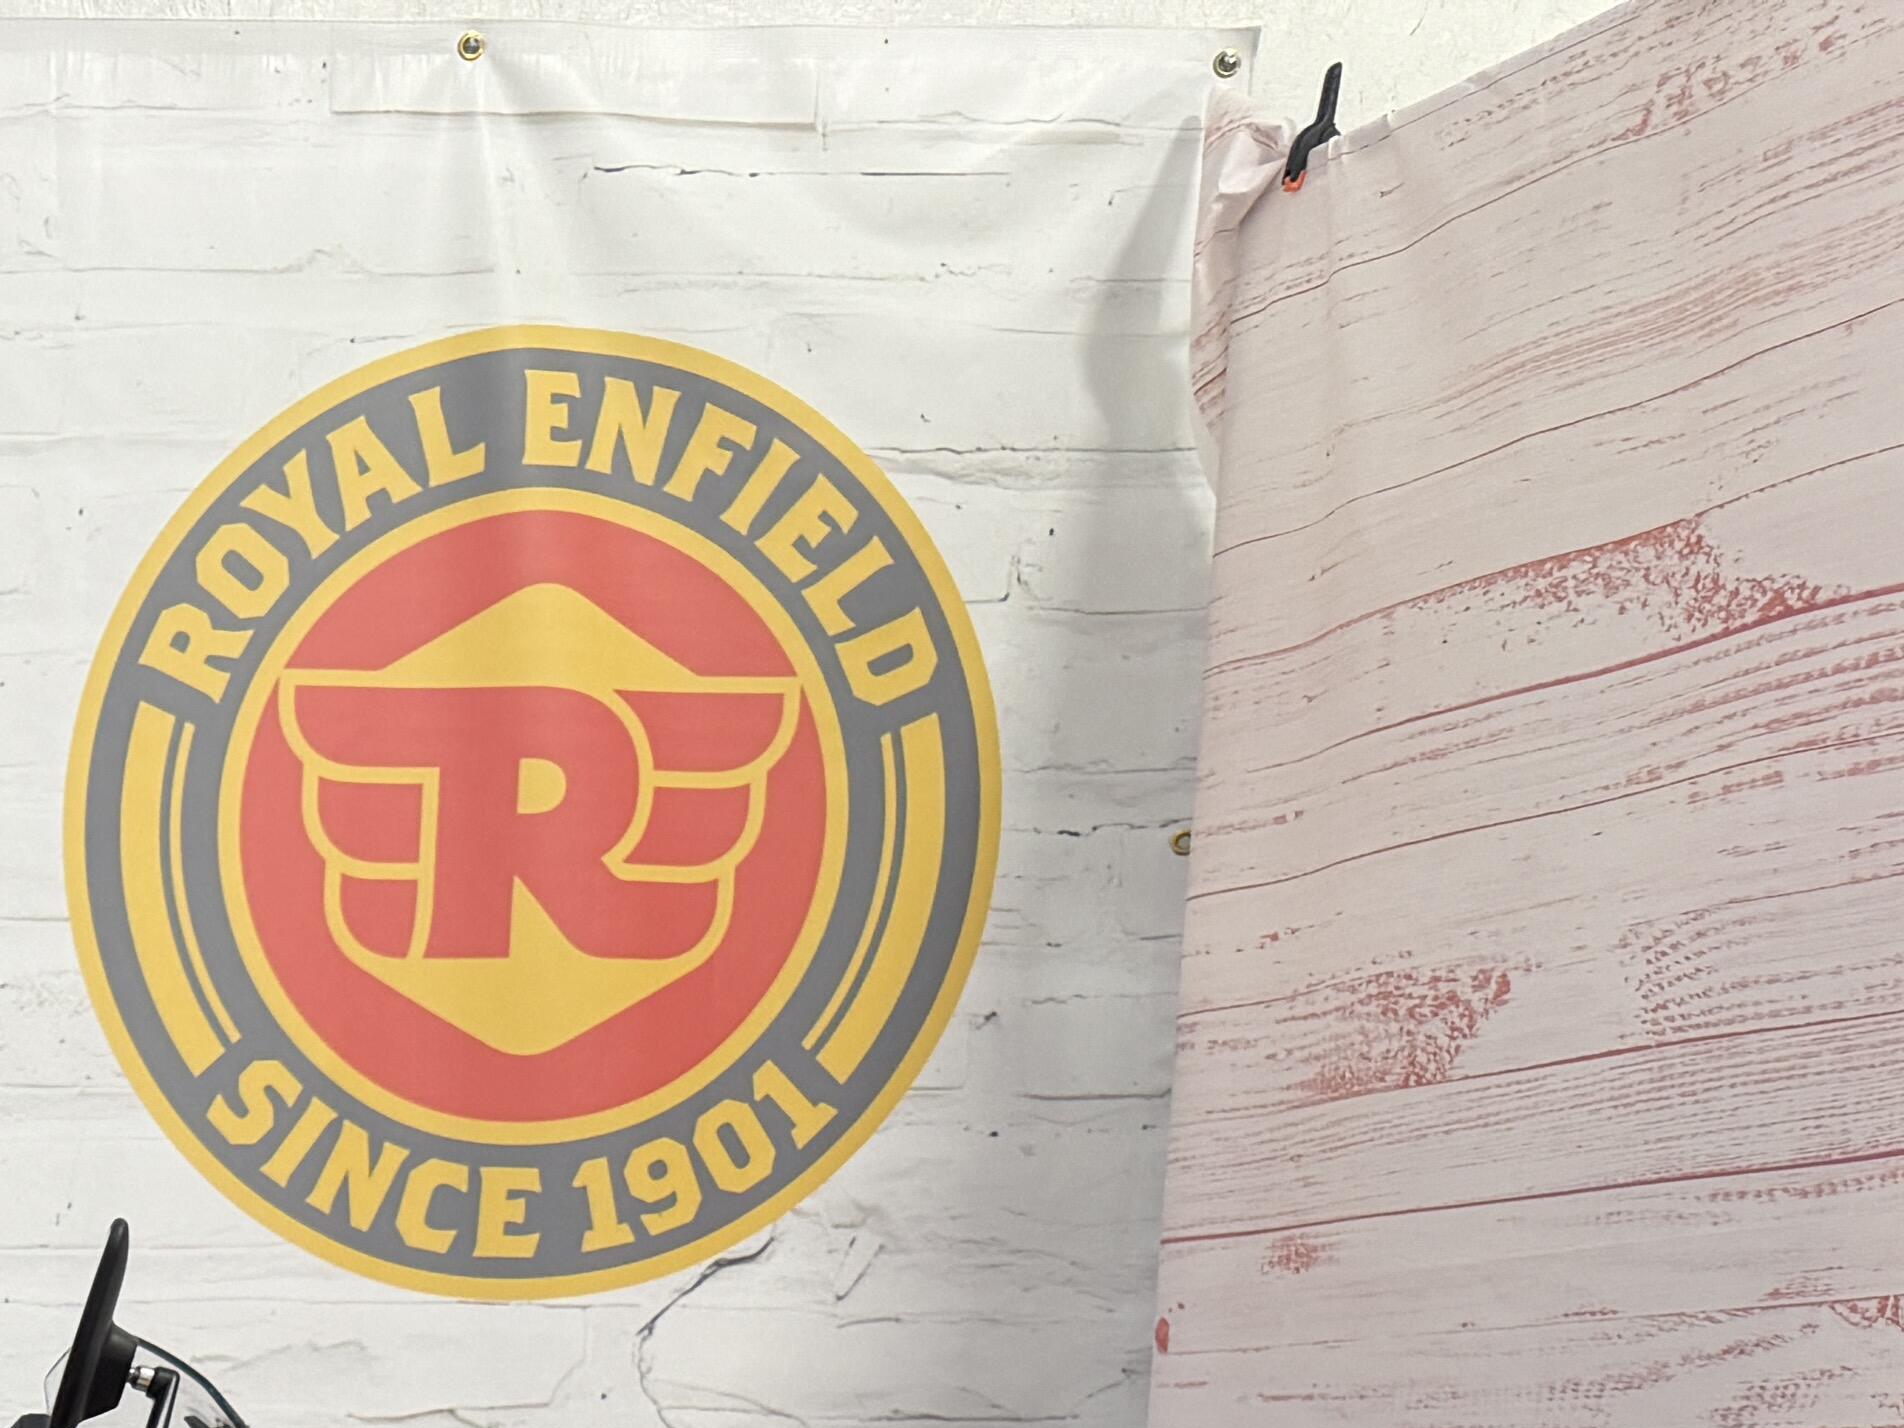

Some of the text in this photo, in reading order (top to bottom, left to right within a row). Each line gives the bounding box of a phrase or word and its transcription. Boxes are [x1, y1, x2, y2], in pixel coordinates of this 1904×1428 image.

[137, 368, 940, 707] ROYAL ENFIELD
[205, 1055, 839, 1259] SINCE 1901
